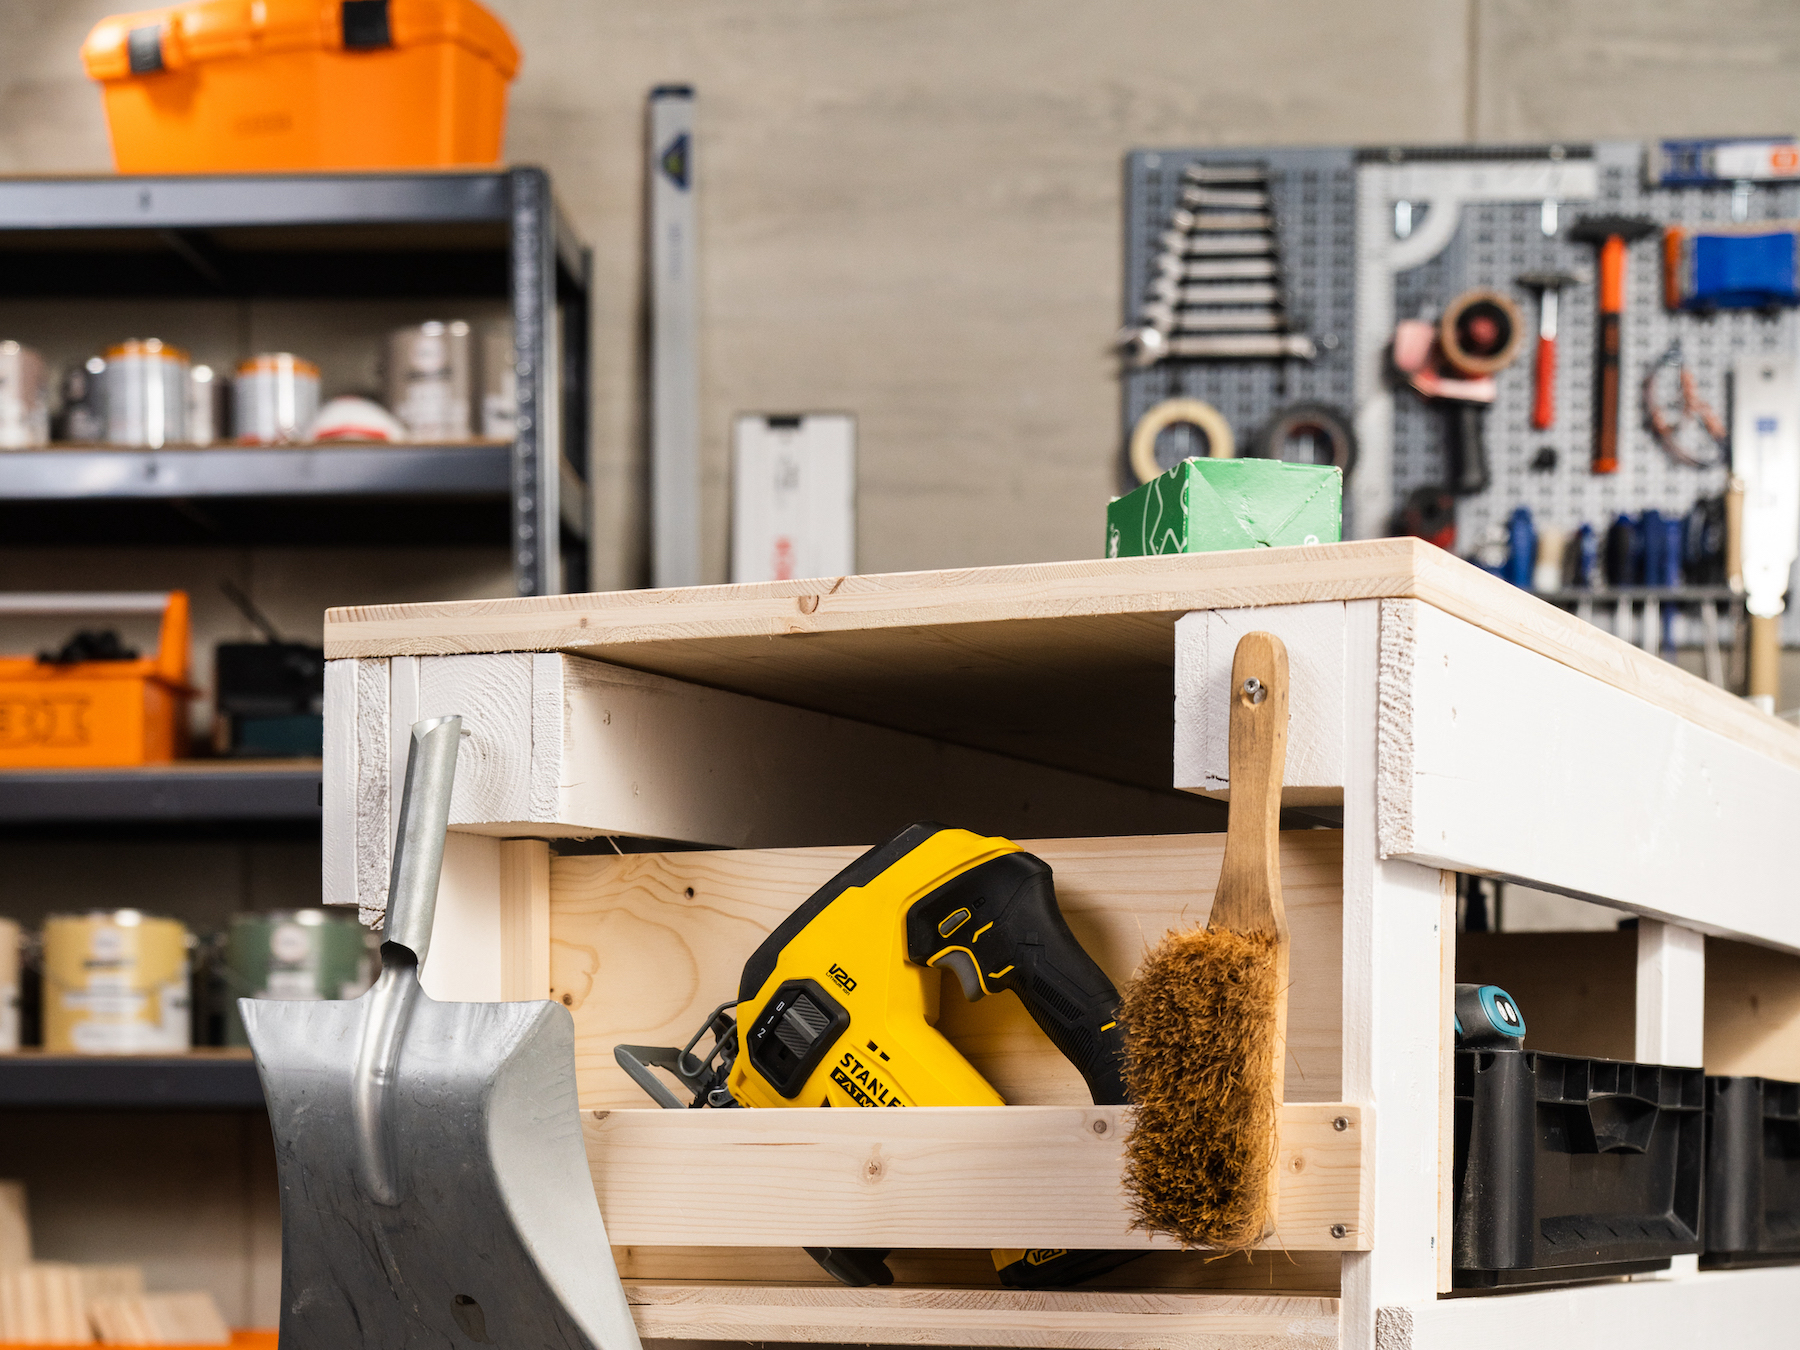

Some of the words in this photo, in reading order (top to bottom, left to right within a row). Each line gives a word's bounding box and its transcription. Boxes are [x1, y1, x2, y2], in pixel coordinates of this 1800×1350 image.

[828, 963, 857, 992] V20
[834, 1072, 874, 1107] FATM
[840, 1053, 906, 1107] STANLE
